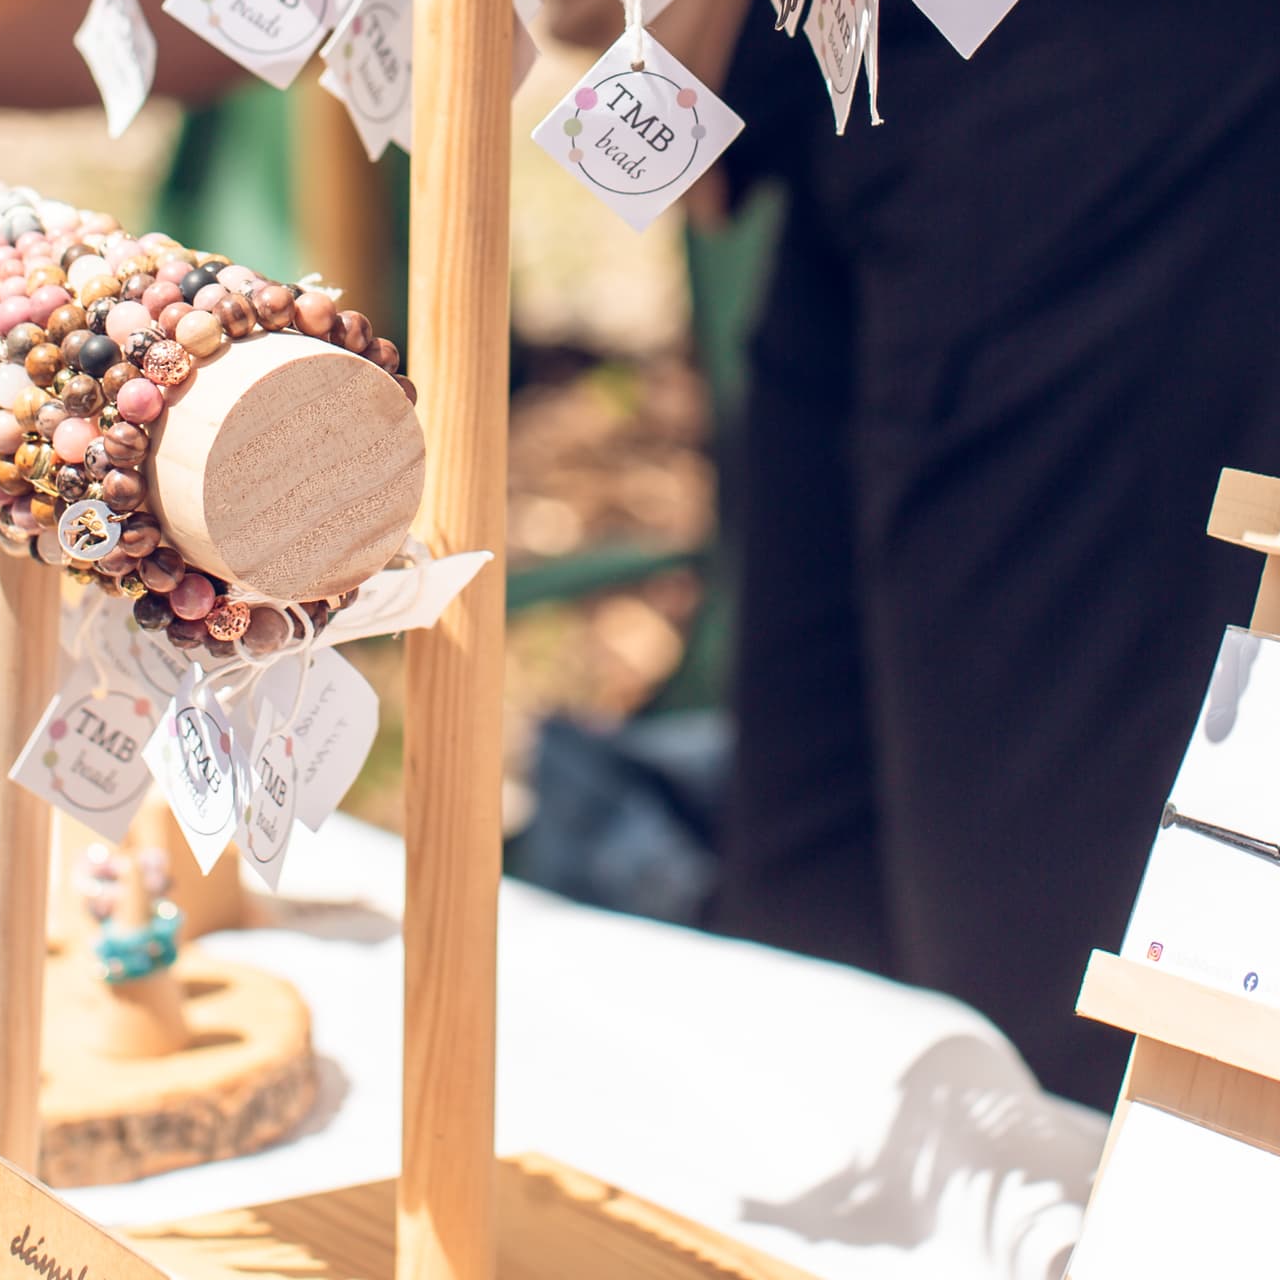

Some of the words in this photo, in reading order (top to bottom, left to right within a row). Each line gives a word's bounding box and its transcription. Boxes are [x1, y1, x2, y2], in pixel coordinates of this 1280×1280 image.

[606, 82, 676, 153] TMB
[594, 126, 648, 180] beads
[74, 708, 138, 764] TMB
[183, 716, 223, 794] TMB
[260, 756, 288, 808] TMB
